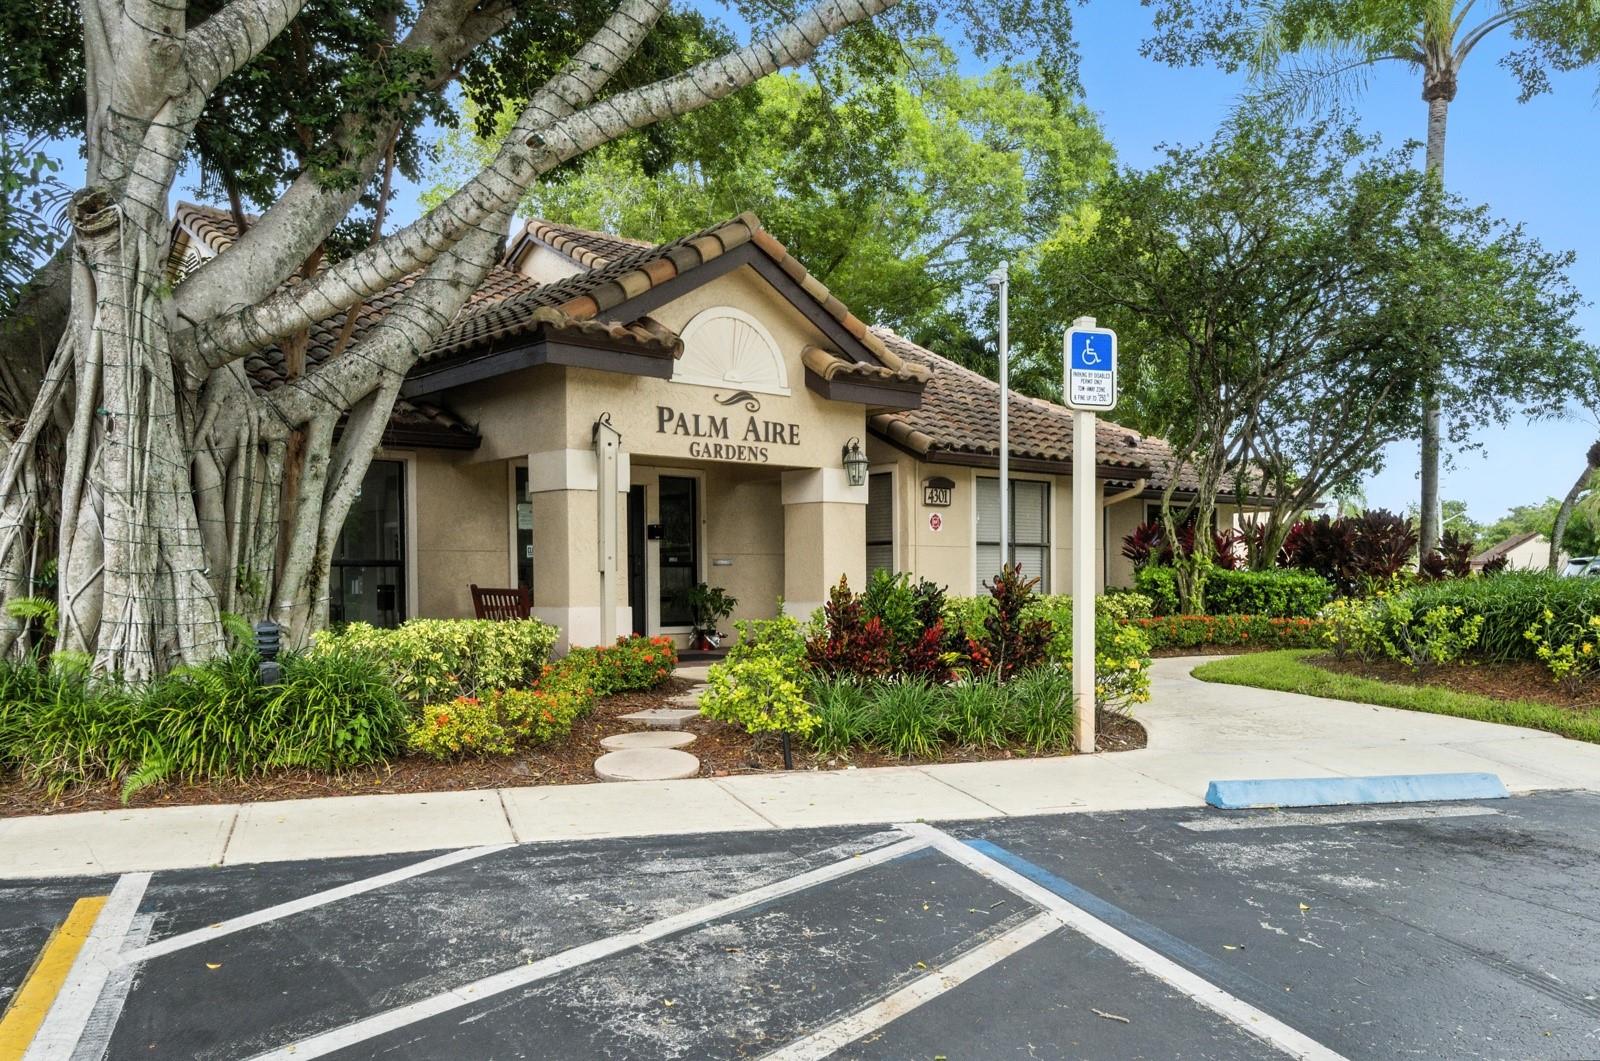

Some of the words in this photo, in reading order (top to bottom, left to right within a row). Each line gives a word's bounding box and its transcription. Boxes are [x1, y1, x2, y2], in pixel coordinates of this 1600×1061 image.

[656, 405, 730, 440] PALM
[742, 415, 801, 446] AIRE
[689, 441, 769, 463] GARDENS
[927, 487, 948, 504] 4301
